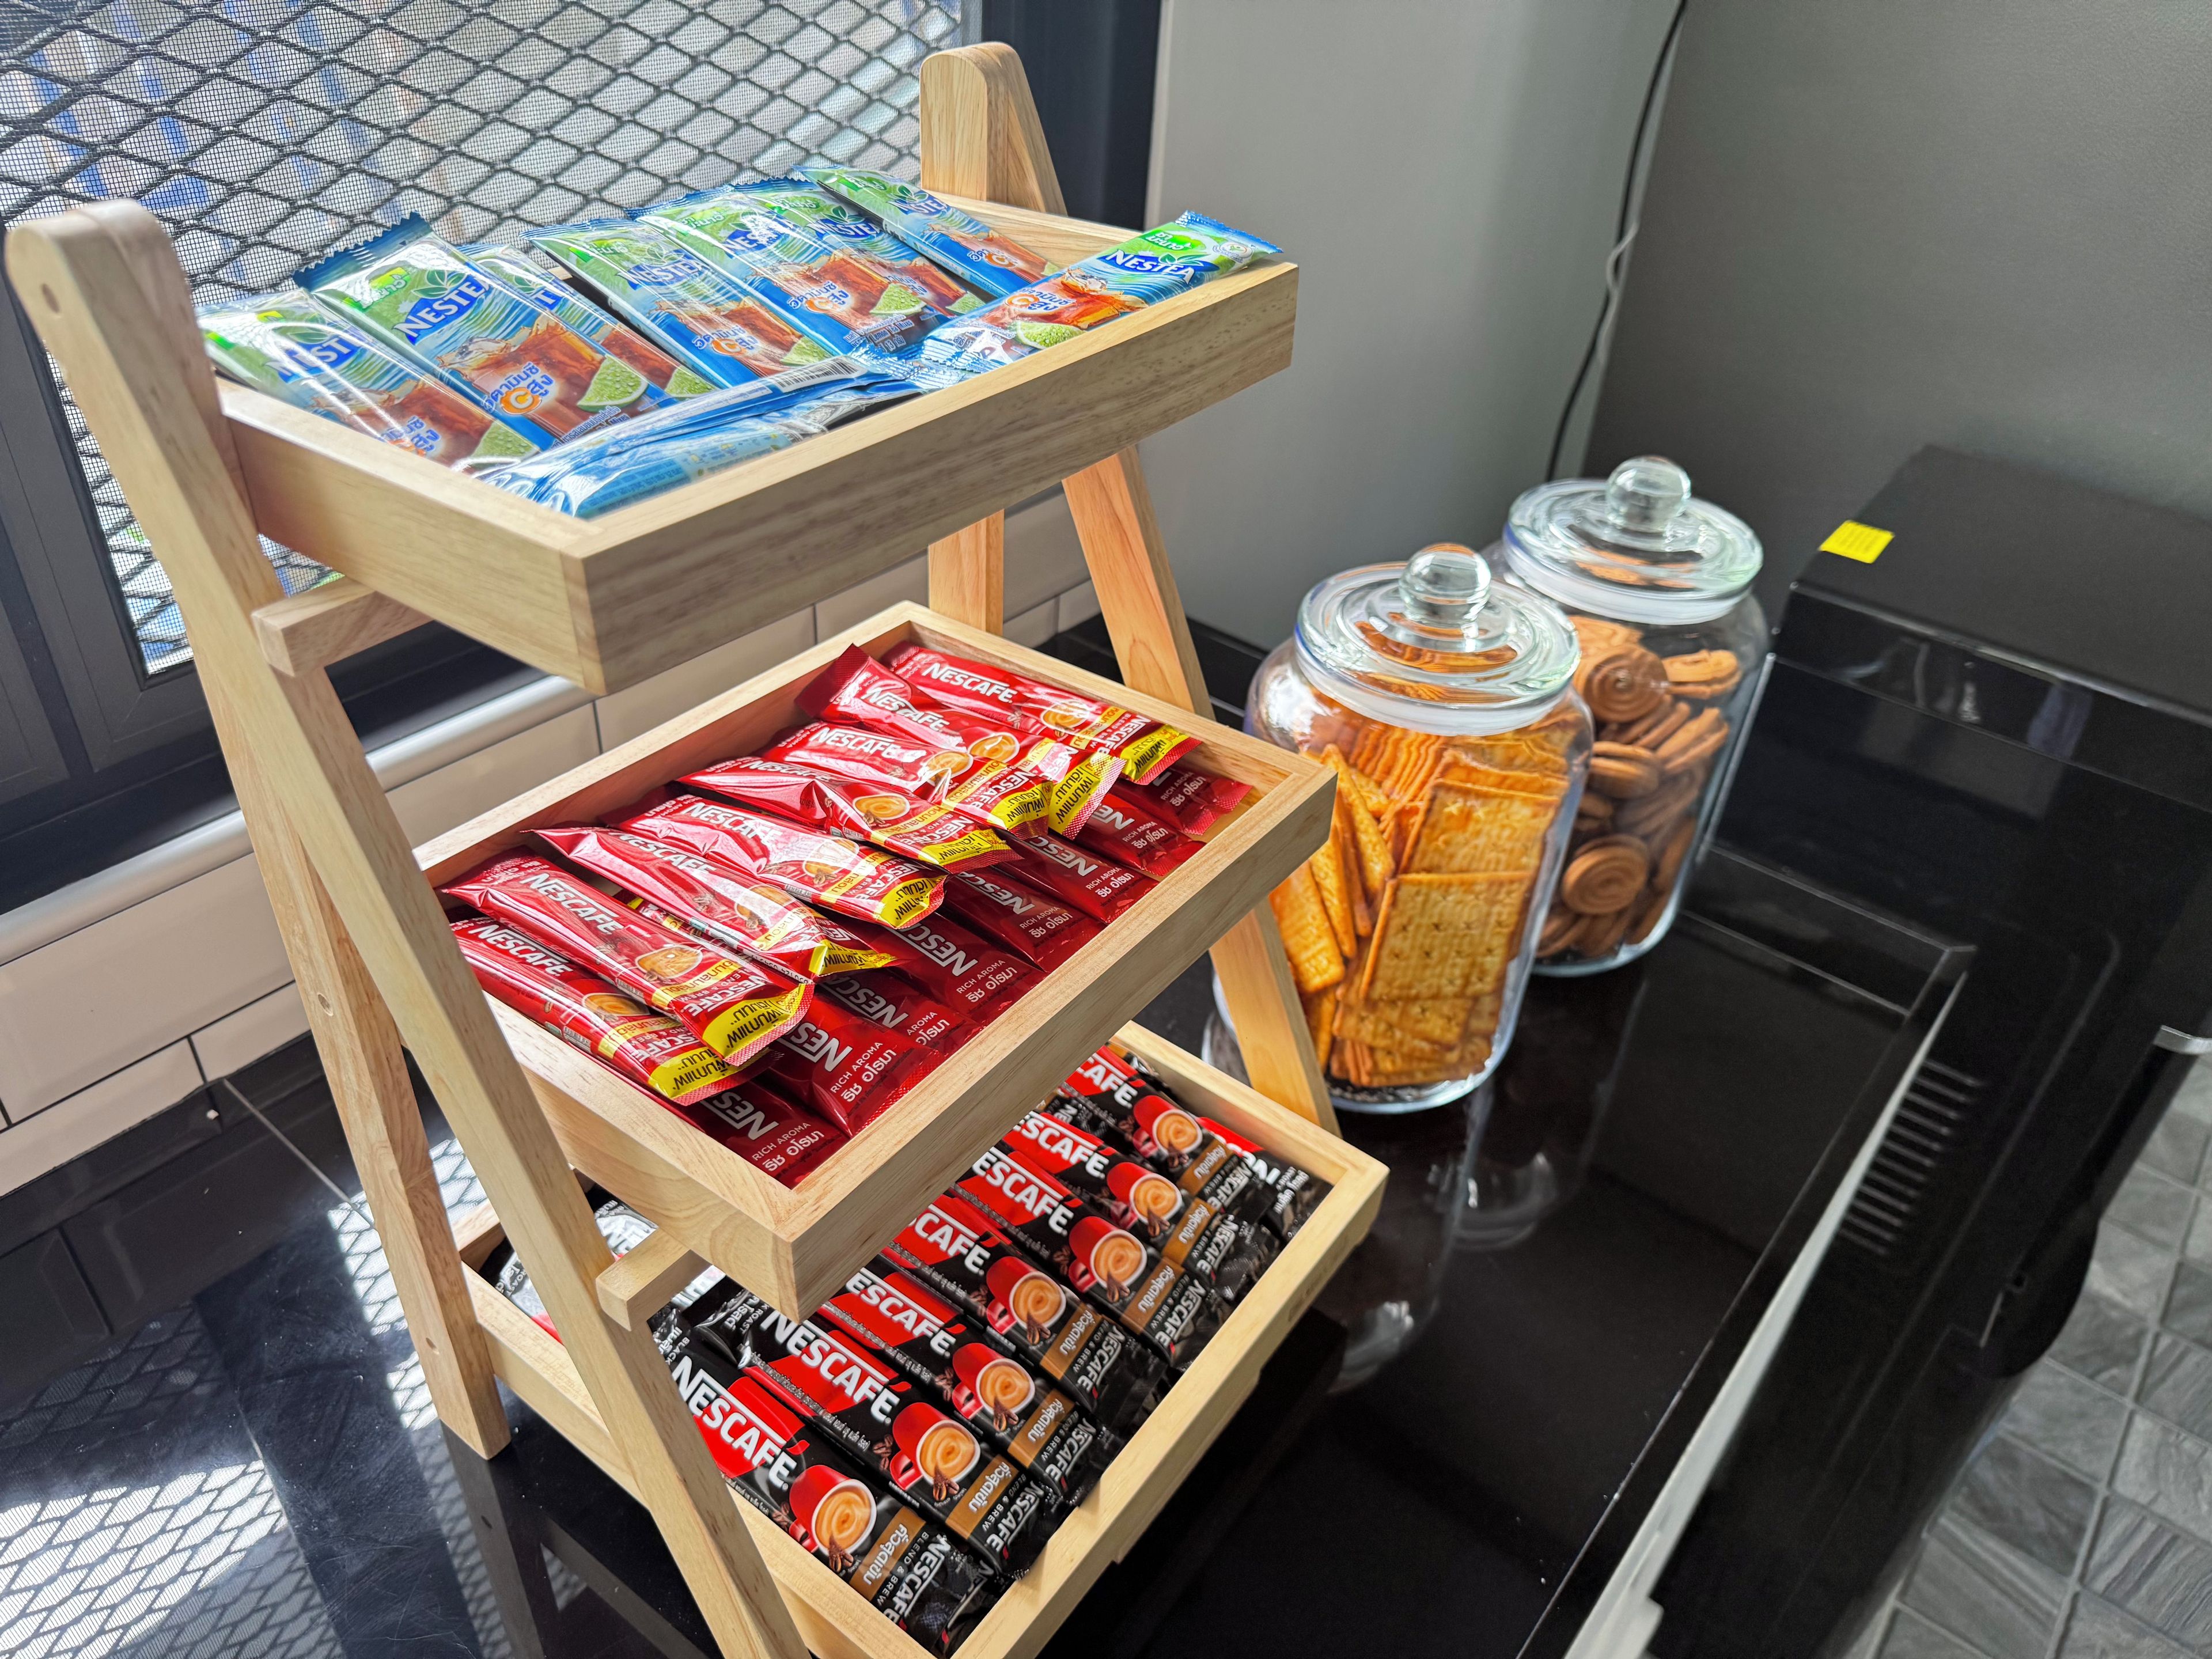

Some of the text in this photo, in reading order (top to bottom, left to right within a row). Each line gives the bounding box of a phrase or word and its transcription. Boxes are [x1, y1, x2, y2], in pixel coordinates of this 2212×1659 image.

[1105, 249, 1196, 285] NESTEA
[527, 373, 554, 398] สูง
[1057, 768, 1084, 802] เติมนม
[1060, 775, 1094, 823] เพิ่มกาแฟ
[1028, 835, 1099, 877] NESC
[1085, 866, 1123, 891] RICH AROMA
[1094, 871, 1136, 899] ริช อโรมา
[520, 873, 626, 935] NESCAFE
[1020, 906, 1061, 930] RICH AROMA
[1028, 911, 1074, 939] ริช อโรมา
[468, 924, 574, 976] NESCAFE
[892, 922, 978, 978] NESC
[662, 959, 734, 995] อมกลมกล่อม
[956, 959, 1006, 995] RICH AROMA
[965, 966, 1018, 1003] ริช อโรมา
[906, 1011, 938, 1036] AROMA
[830, 1071, 853, 1093] RICH
[851, 1041, 884, 1072] AROMA
[840, 1048, 897, 1103] ริช อโรมา
[751, 1142, 777, 1162] RICH
[778, 1122, 812, 1145] AROMA
[762, 1155, 786, 1172] ริช
[786, 1130, 825, 1157] อโรมา
[1059, 1309, 1096, 1355] คั่วสุดเข้ม
[1151, 1304, 1170, 1329] BREW
[1073, 1347, 1092, 1373] BREW
[1028, 1397, 1066, 1444] คั่วสุดเข้ม
[1040, 1434, 1060, 1462] BREW
[968, 1461, 1012, 1513] คั่วสุดเข้ม
[982, 1503, 1004, 1532] BREW
[862, 1523, 911, 1586] คั่วสุดเข้ม
[902, 1532, 930, 1569] BLEND
[876, 1575, 899, 1607] BREW
